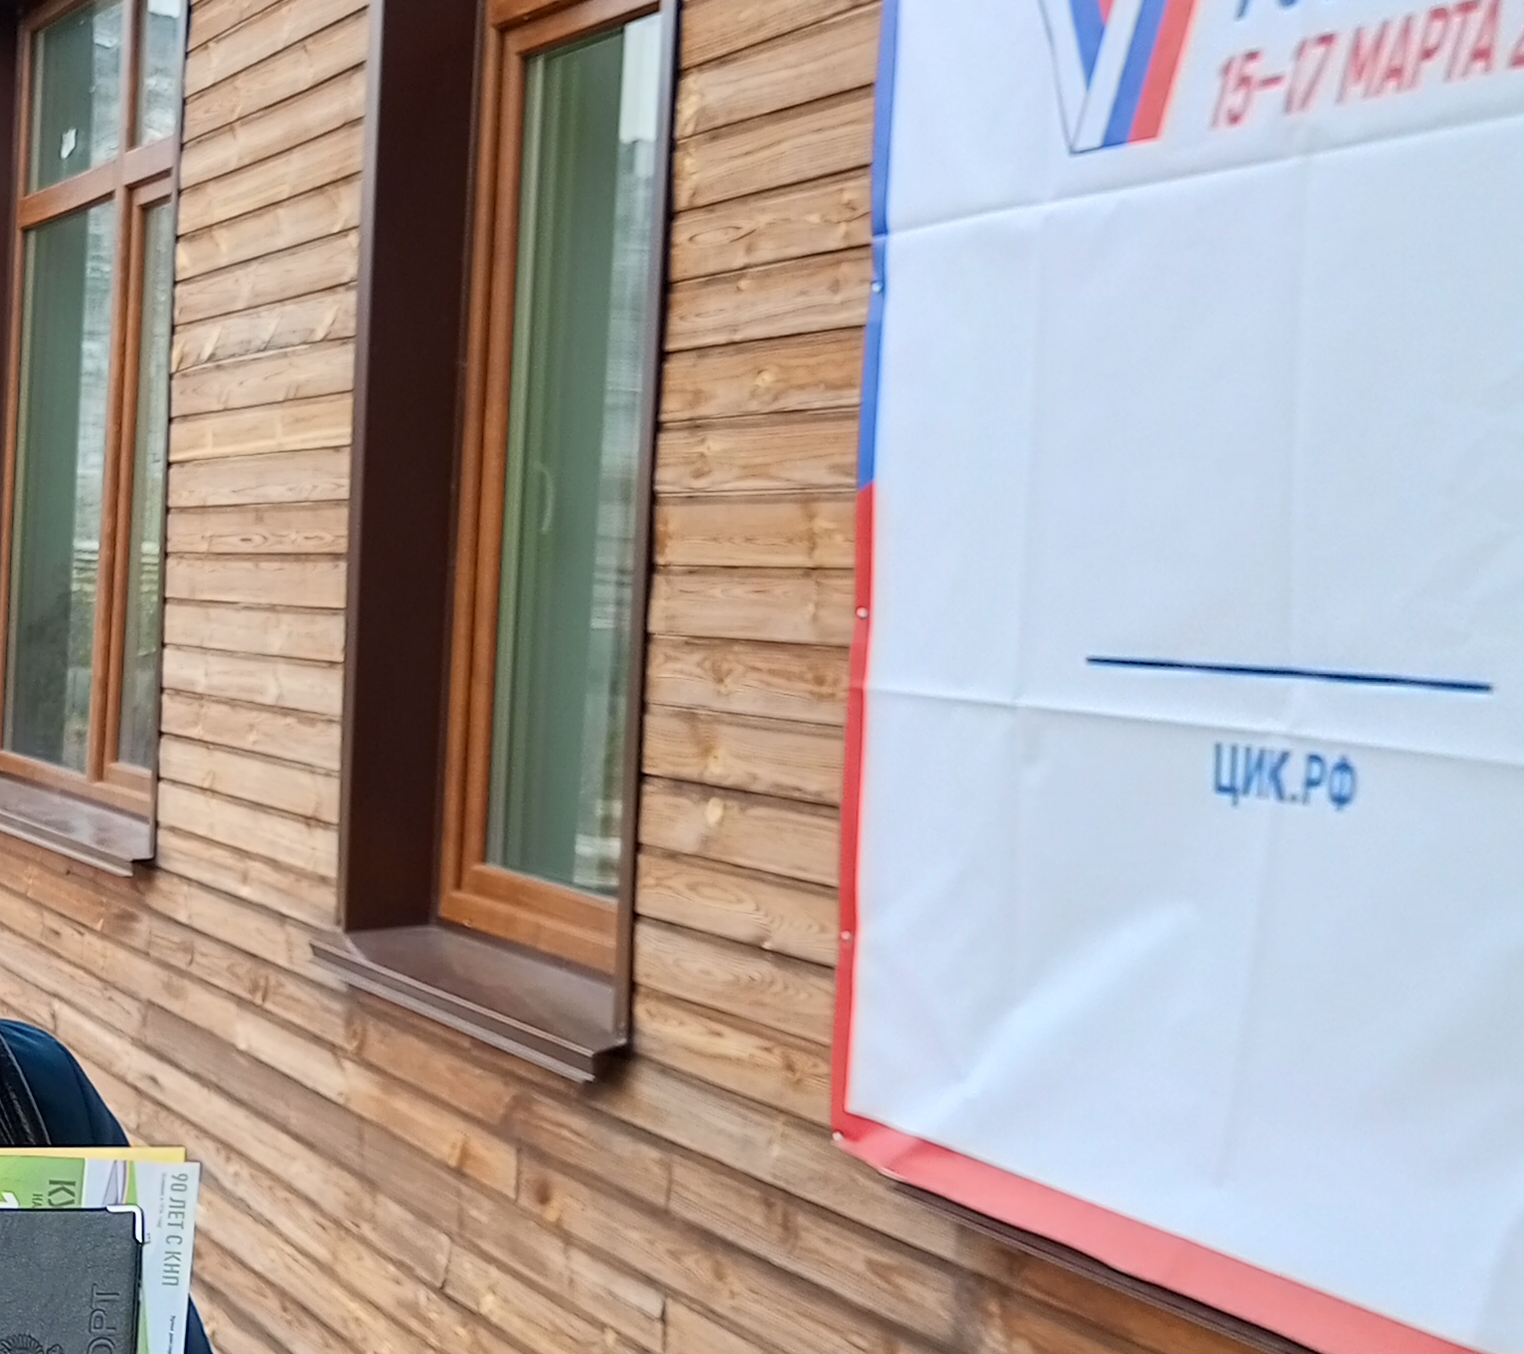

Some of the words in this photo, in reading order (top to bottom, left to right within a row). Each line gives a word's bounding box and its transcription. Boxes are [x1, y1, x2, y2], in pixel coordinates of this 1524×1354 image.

[1213, 741, 1357, 811] ЦИК.РФ
[170, 1173, 188, 1192] 90
[167, 1196, 186, 1230] ЛЕТ
[165, 1234, 183, 1246] С
[161, 1250, 182, 1287] КНП
